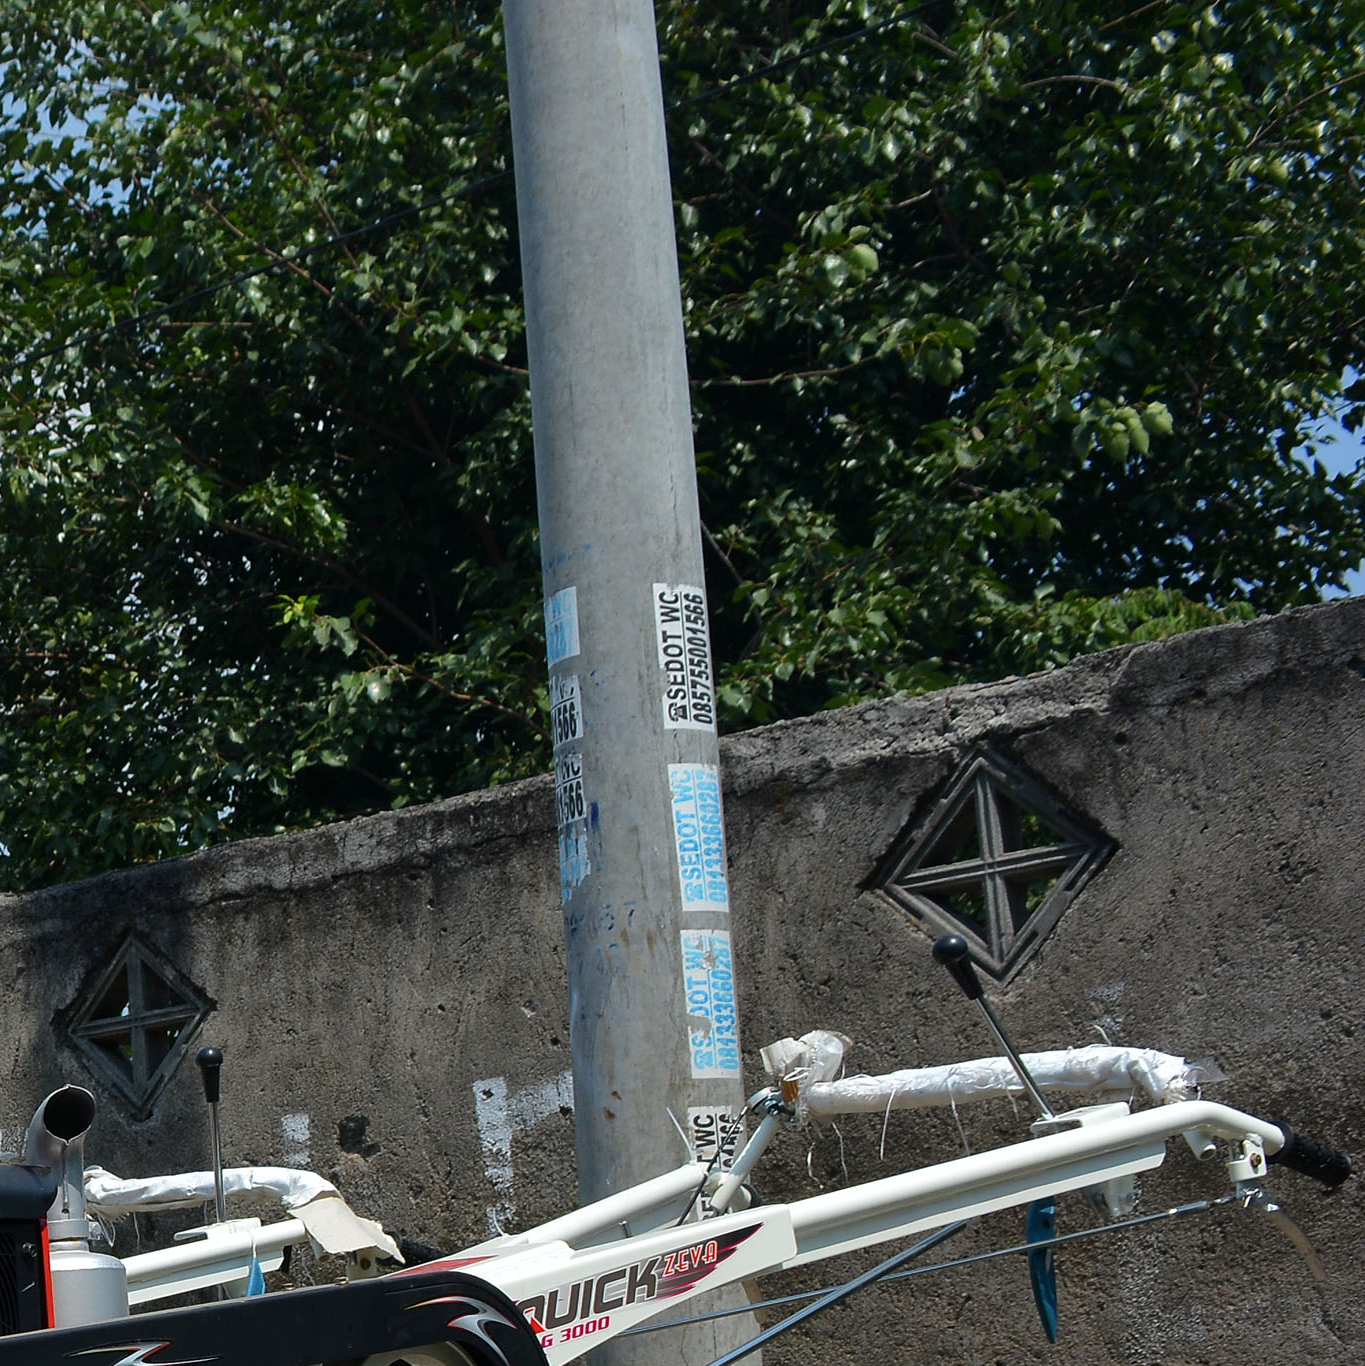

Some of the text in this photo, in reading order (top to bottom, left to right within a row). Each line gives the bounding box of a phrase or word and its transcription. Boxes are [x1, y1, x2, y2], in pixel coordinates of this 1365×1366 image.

[658, 591, 687, 701] SEDOT WC
[683, 593, 713, 725] 085755001566
[670, 769, 702, 881] SEDOT WC
[693, 1114, 717, 1149] WC
[516, 1240, 718, 1331] QUICK ZEVA
[541, 1315, 611, 1348] G 3000
